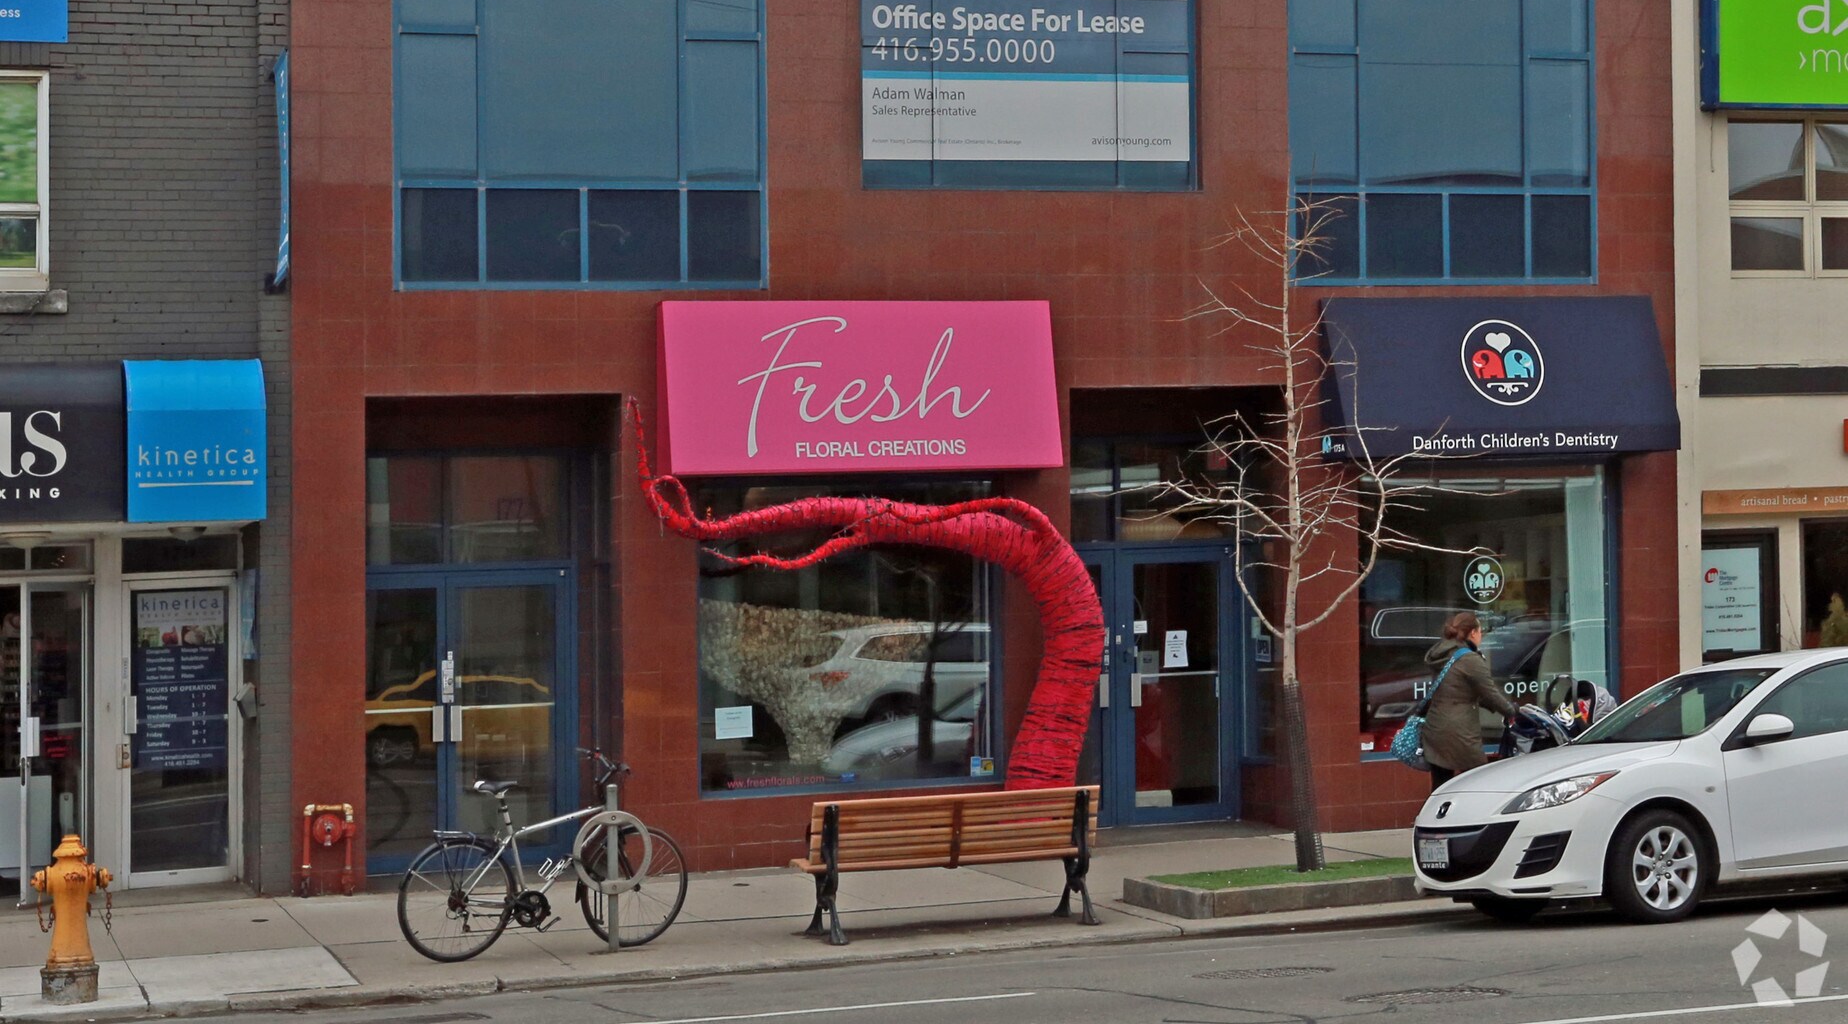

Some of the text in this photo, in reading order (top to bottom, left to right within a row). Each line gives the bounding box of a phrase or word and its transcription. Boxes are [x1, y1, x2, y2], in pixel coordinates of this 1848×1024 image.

[871, 4, 1145, 35] Office Space For Lease
[871, 36, 1055, 64] 416.955.0000
[1812, 49, 1848, 73] m
[872, 87, 966, 100] Adam Walman
[872, 105, 977, 119] Sales Representative
[1091, 136, 1172, 147] avisonyoung.com
[738, 316, 991, 458] Fresh
[795, 439, 966, 458] FLORAL CREATIONS
[1412, 432, 1618, 451] Danforth Children's Dentistry
[138, 444, 256, 466] kinetica
[135, 468, 260, 478] HEALTH GROUP
[1740, 495, 1780, 507] artisanal
[1782, 494, 1808, 506] bread
[141, 595, 219, 611] kinetica
[145, 687, 168, 695] HOURS
[179, 684, 217, 692] OPERATION
